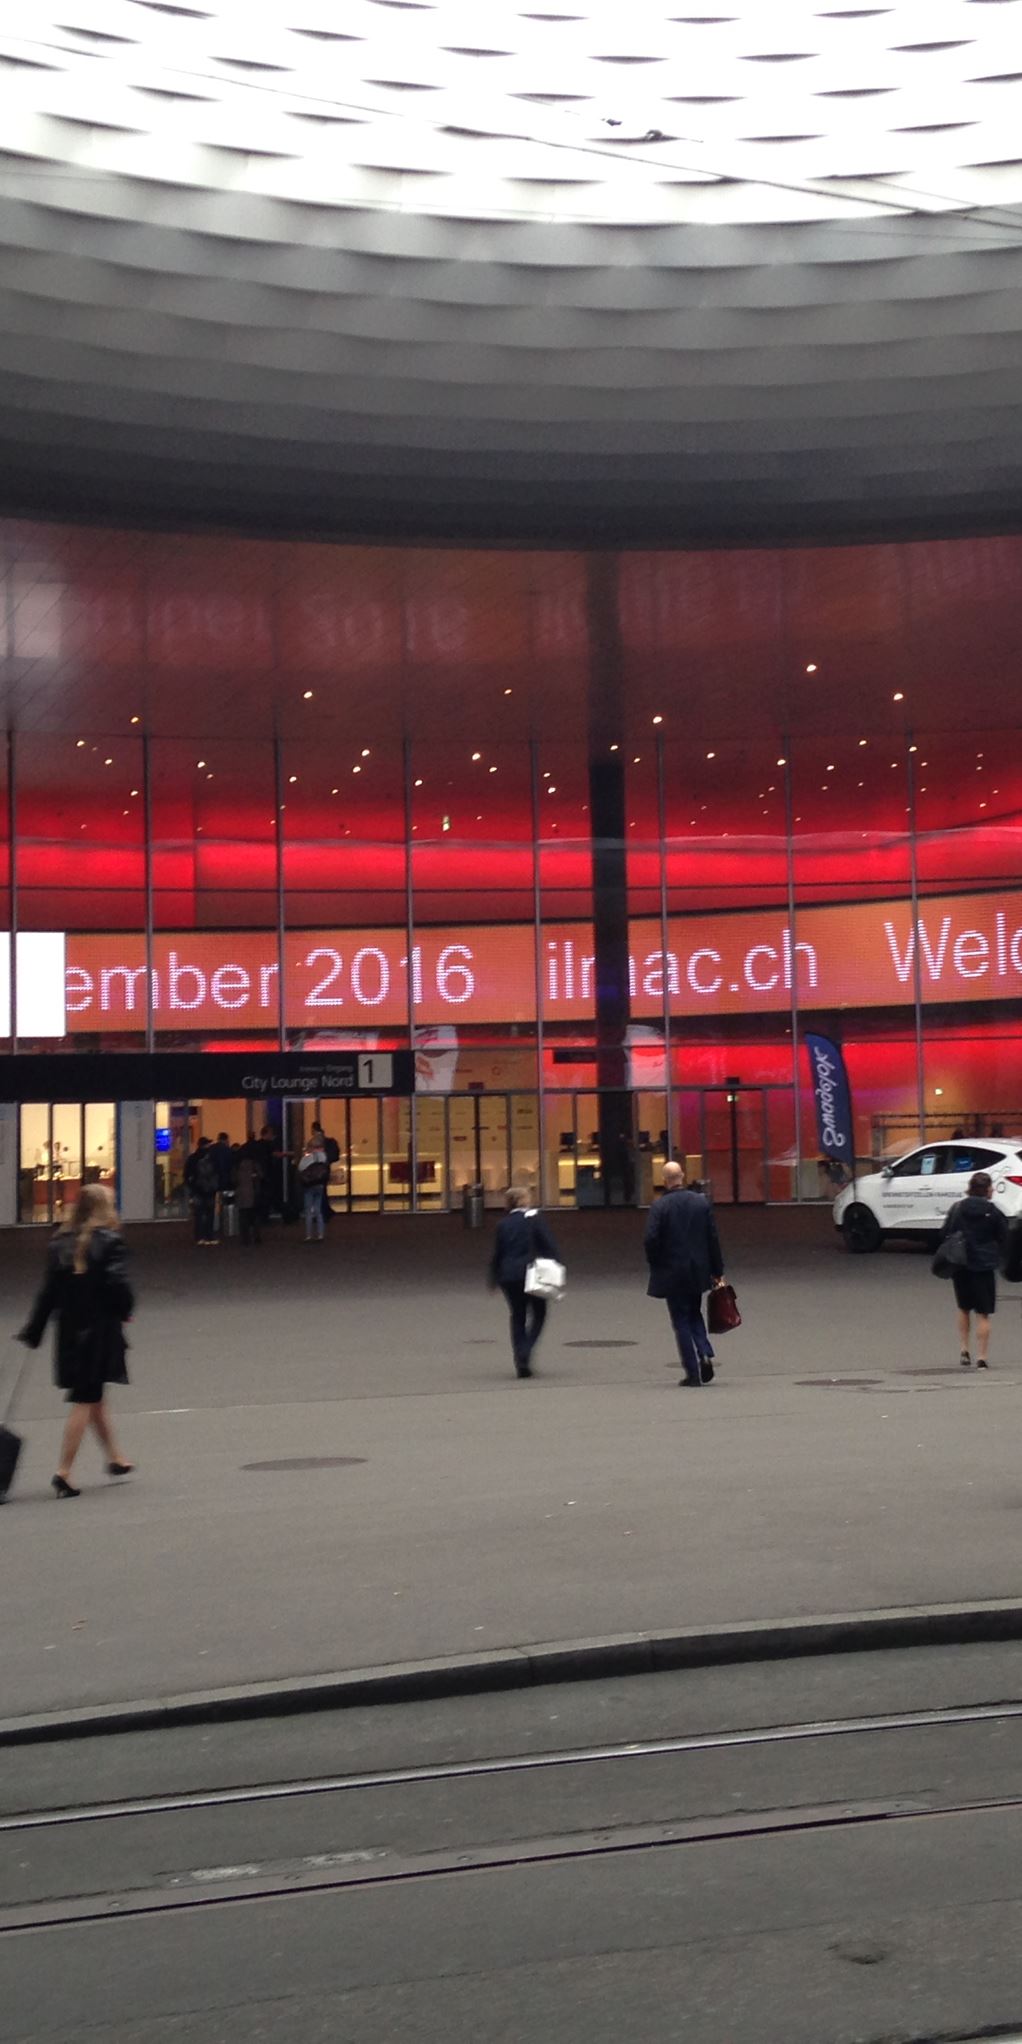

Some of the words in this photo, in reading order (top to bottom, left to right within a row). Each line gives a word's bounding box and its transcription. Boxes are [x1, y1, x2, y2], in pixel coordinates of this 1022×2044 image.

[304, 943, 476, 1006] 2016
[241, 1075, 267, 1092] City
[270, 1075, 318, 1092] Lounge
[322, 1074, 354, 1088] Nord
[363, 1058, 374, 1084] 1
